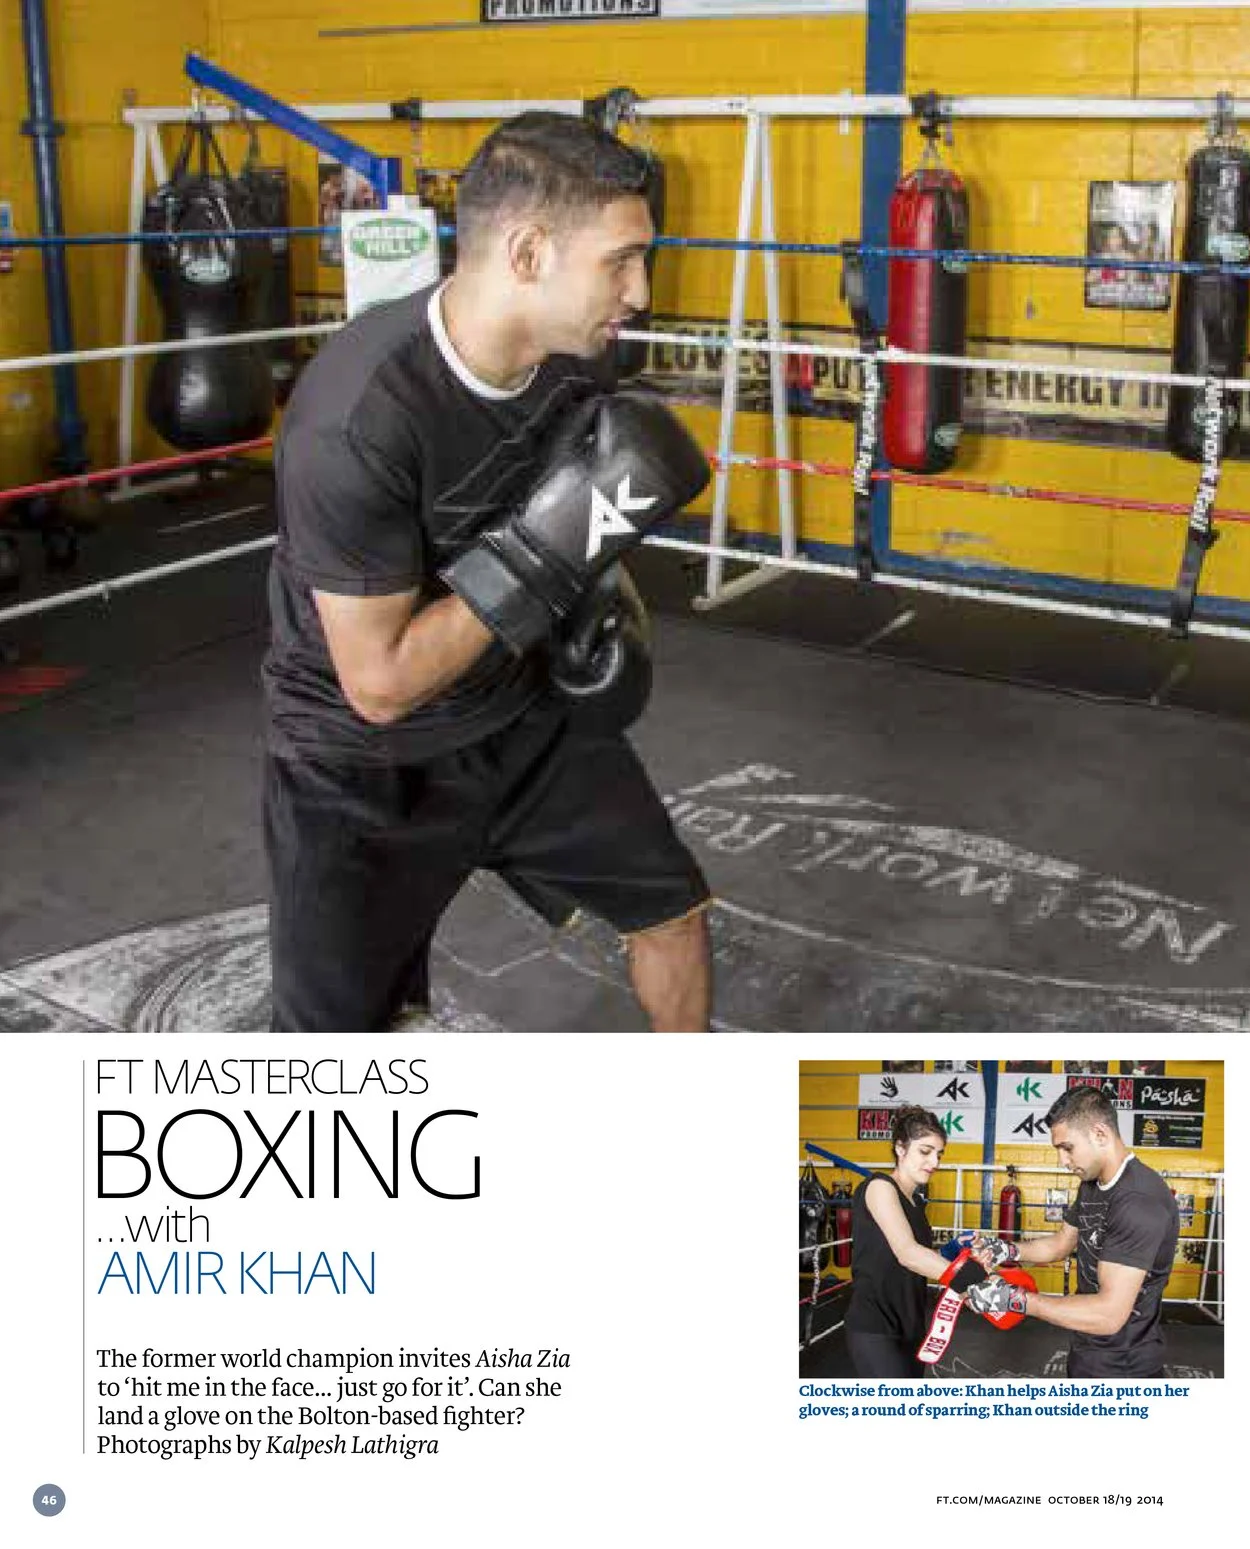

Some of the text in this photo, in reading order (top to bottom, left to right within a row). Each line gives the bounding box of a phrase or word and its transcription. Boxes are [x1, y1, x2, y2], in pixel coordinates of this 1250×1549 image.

[985, 368, 1126, 409] ENERGY
[97, 1058, 429, 1095] FT MASTERCLASS
[97, 1108, 481, 1201] BOXING
[97, 1250, 375, 1295] AMIR KHAN
[96, 1346, 570, 1374] The former world champion invites Aisha Zia
[97, 1375, 561, 1403] to ‘hit me in the face... just go for it’. Can she
[798, 1382, 1189, 1400] Clockwise from above: Khan helps Aisha Zia put on her
[97, 1405, 526, 1432] land a glove on the Bolton-based fighter?
[798, 1401, 1149, 1420] gloves; a round of sparring; Khan outside the ring
[96, 1433, 440, 1461] Photographs by Kalpesh Lathigra
[40, 1494, 57, 1505] 46
[936, 1493, 1163, 1506] FT.COM/MAGAZINE OCTOBER 18/19 2014
